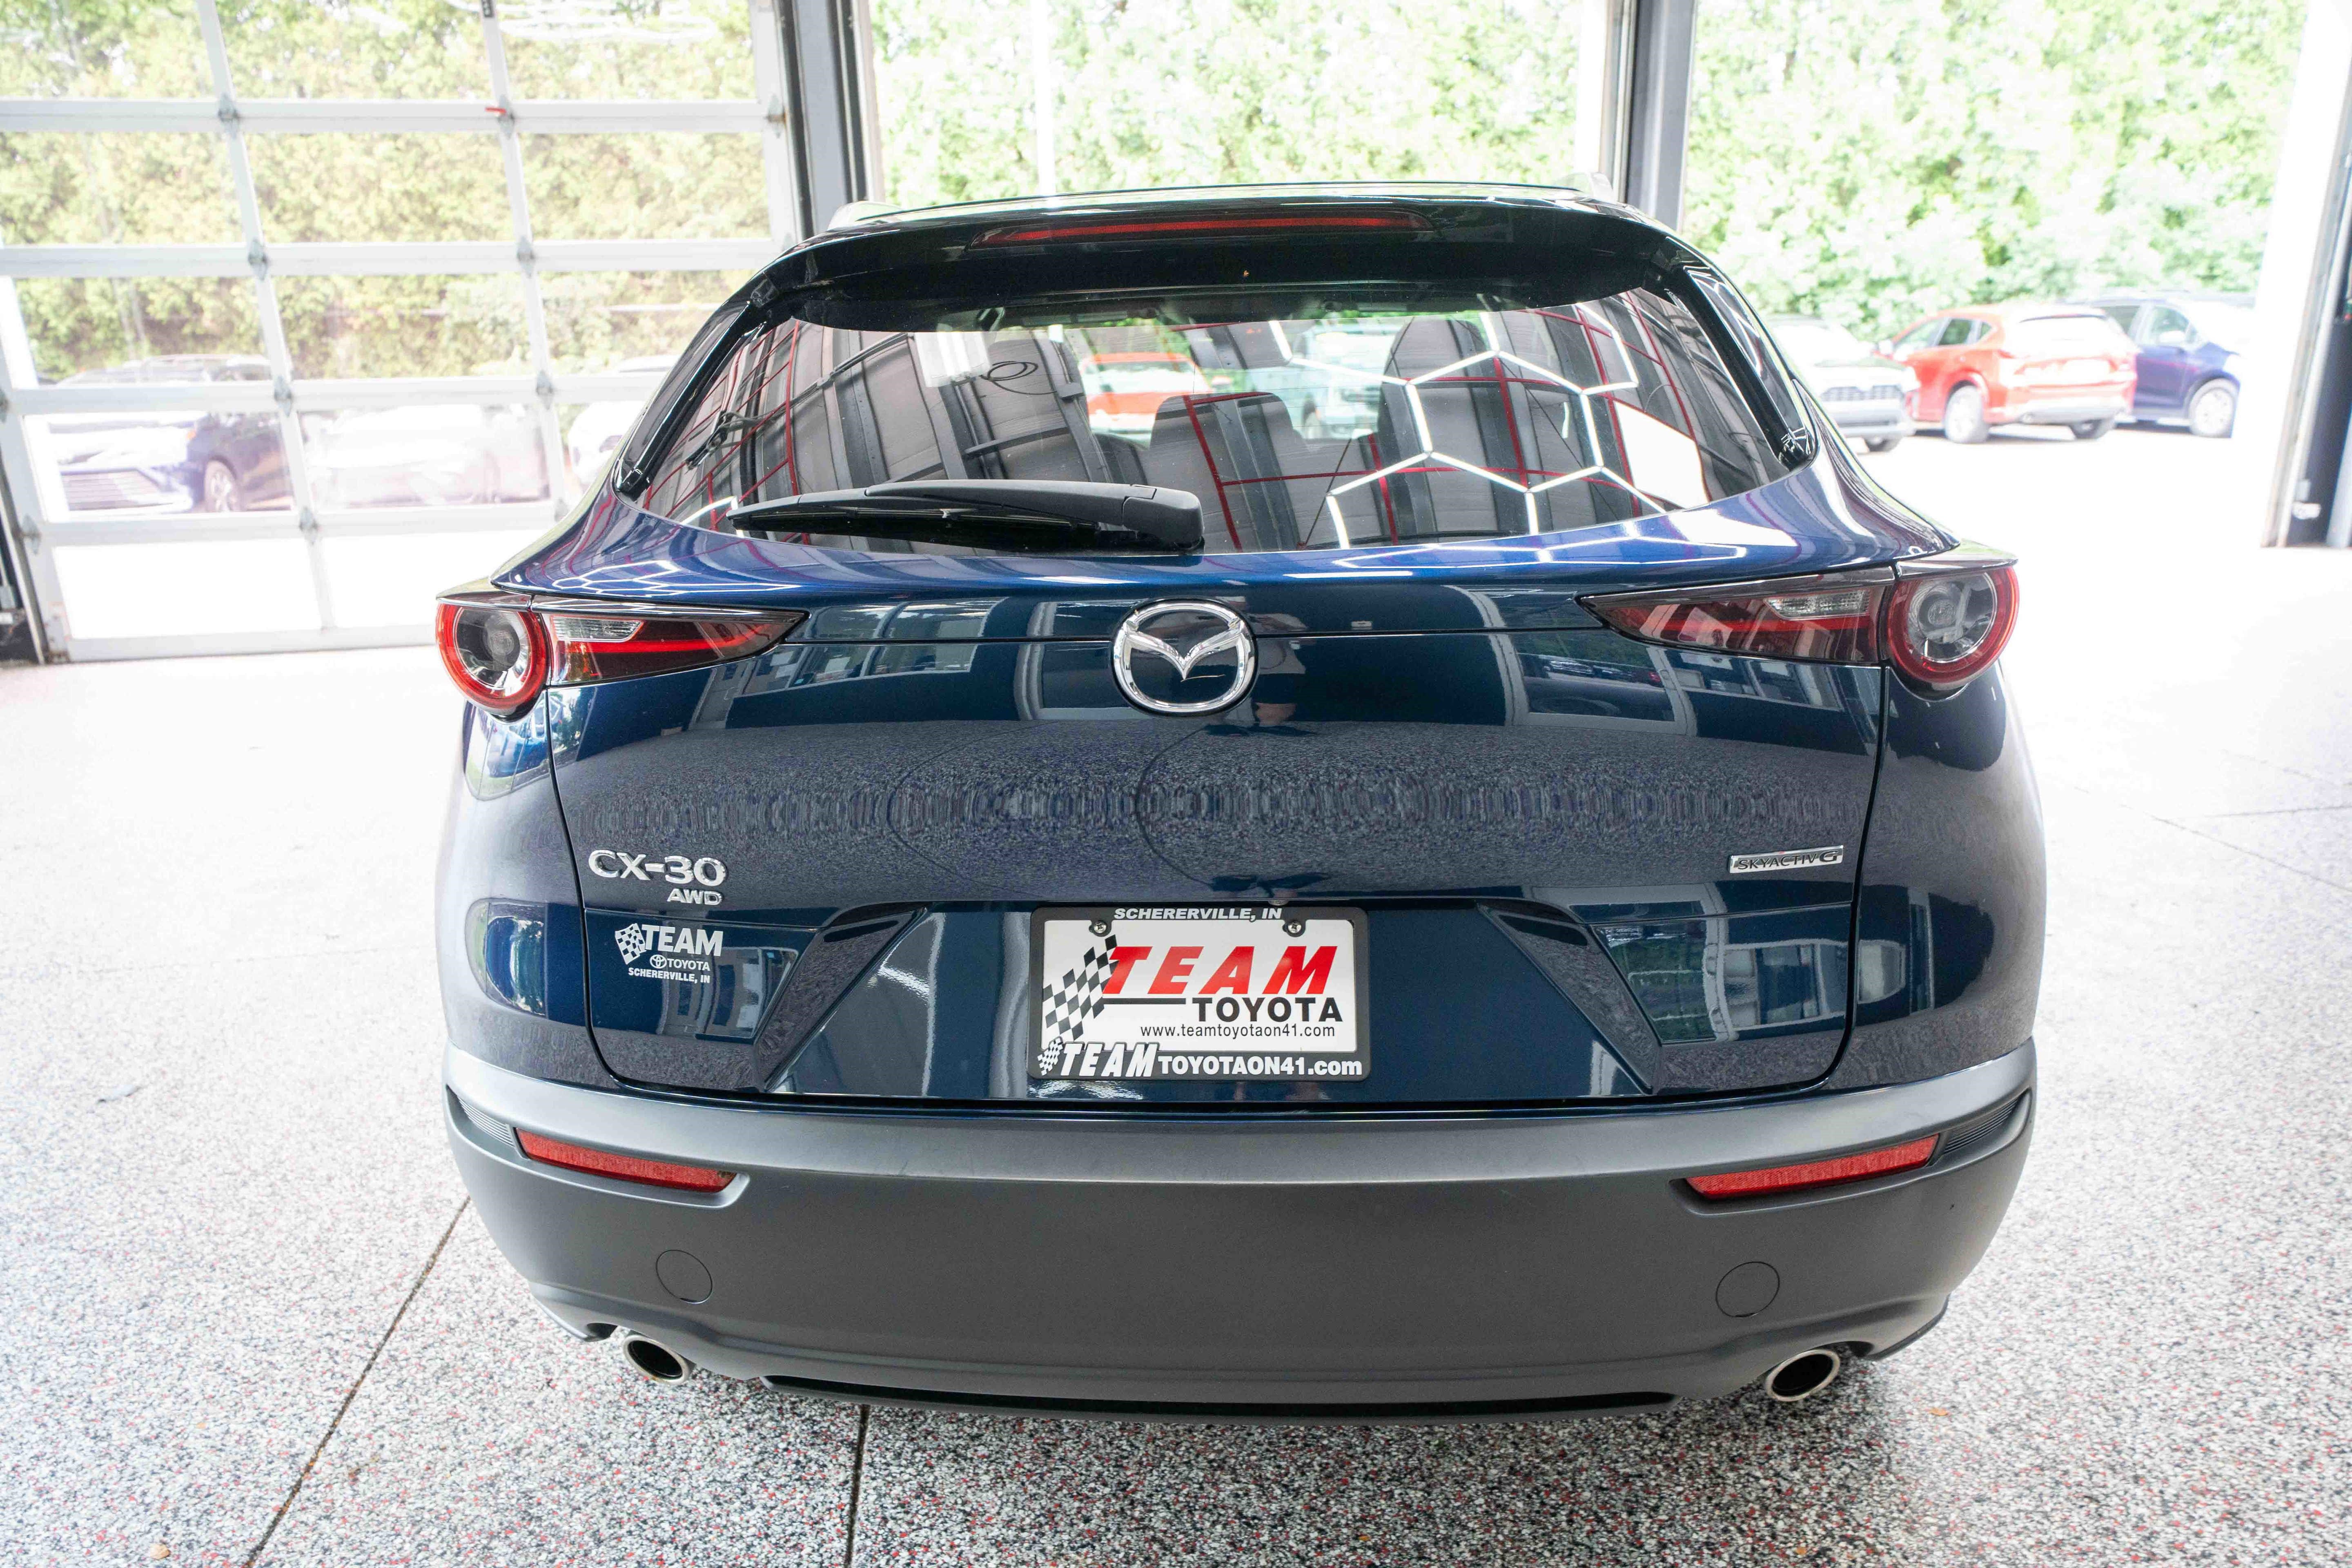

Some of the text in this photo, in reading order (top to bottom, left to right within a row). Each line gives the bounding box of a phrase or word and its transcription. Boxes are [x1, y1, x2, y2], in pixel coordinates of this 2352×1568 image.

[588, 849, 727, 886] CX-30
[667, 888, 722, 905] AWD
[1114, 908, 1282, 922] SCHERERVILLE, IN
[641, 924, 723, 956] TEAM
[628, 967, 697, 983] SCHERERVILLE,
[667, 958, 710, 971] TOYOTA
[1102, 946, 1337, 994] TEAM
[1192, 997, 1343, 1022] TOYOTA
[1140, 1024, 1335, 1039] www.teamtoyotaon41.com
[1060, 1043, 1362, 1077] TEAM TOYOTAON41.com
